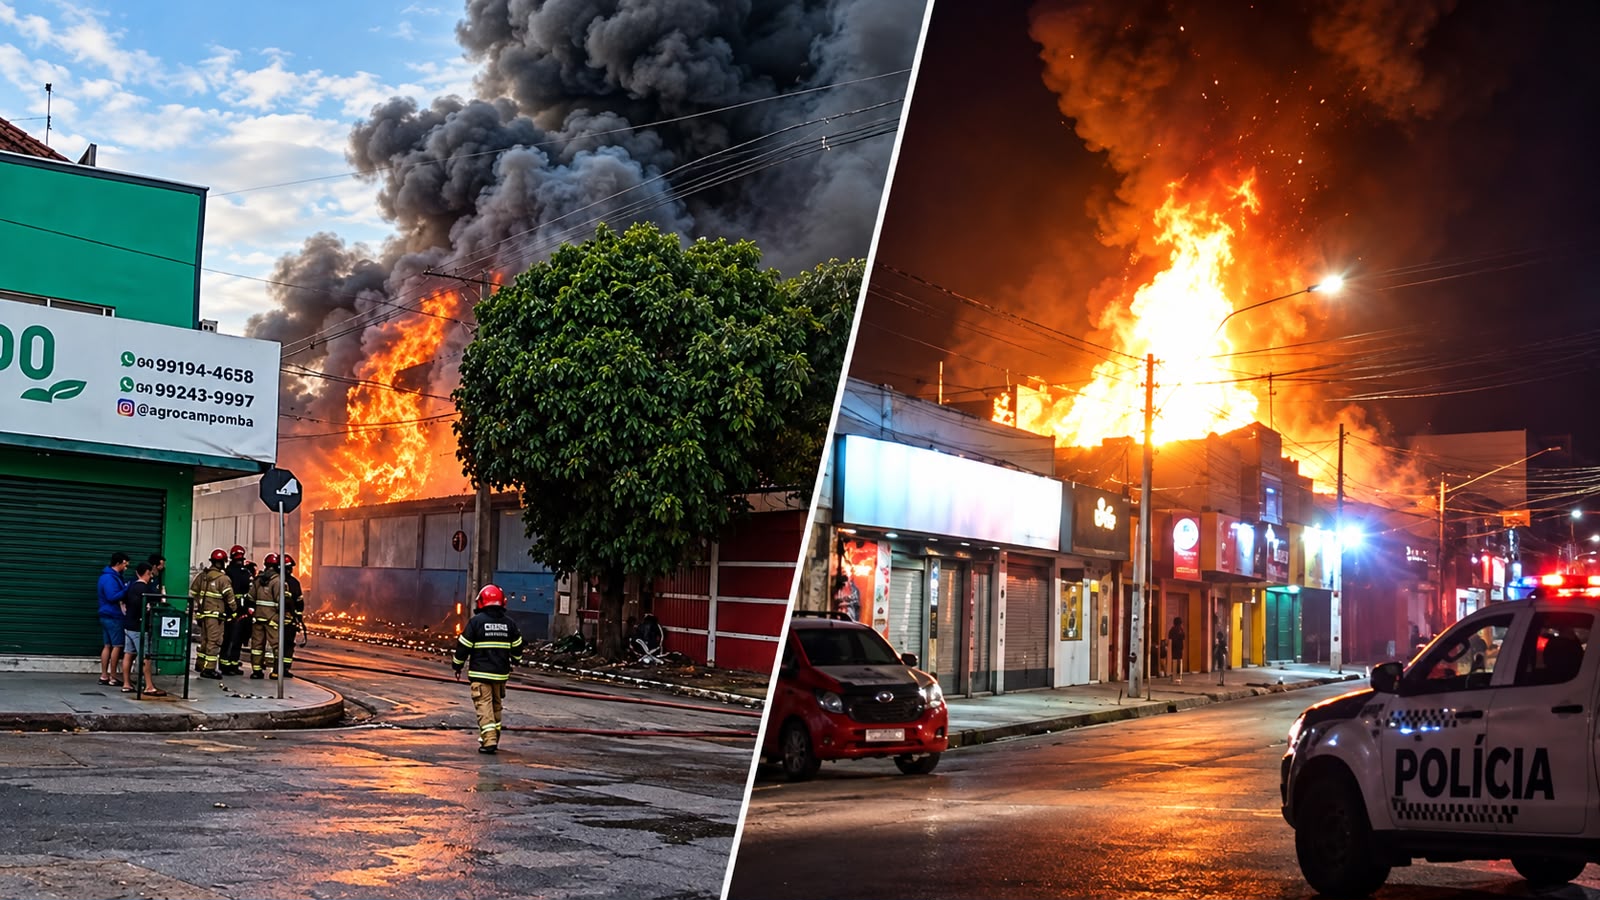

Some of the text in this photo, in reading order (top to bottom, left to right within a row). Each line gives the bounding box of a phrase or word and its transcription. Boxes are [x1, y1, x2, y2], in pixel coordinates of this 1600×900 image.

[156, 358, 254, 384] 99194-4658
[155, 383, 255, 408] 99243-9997
[137, 403, 254, 427] @agrocampomba
[1395, 734, 1555, 800] POLÍCIA
